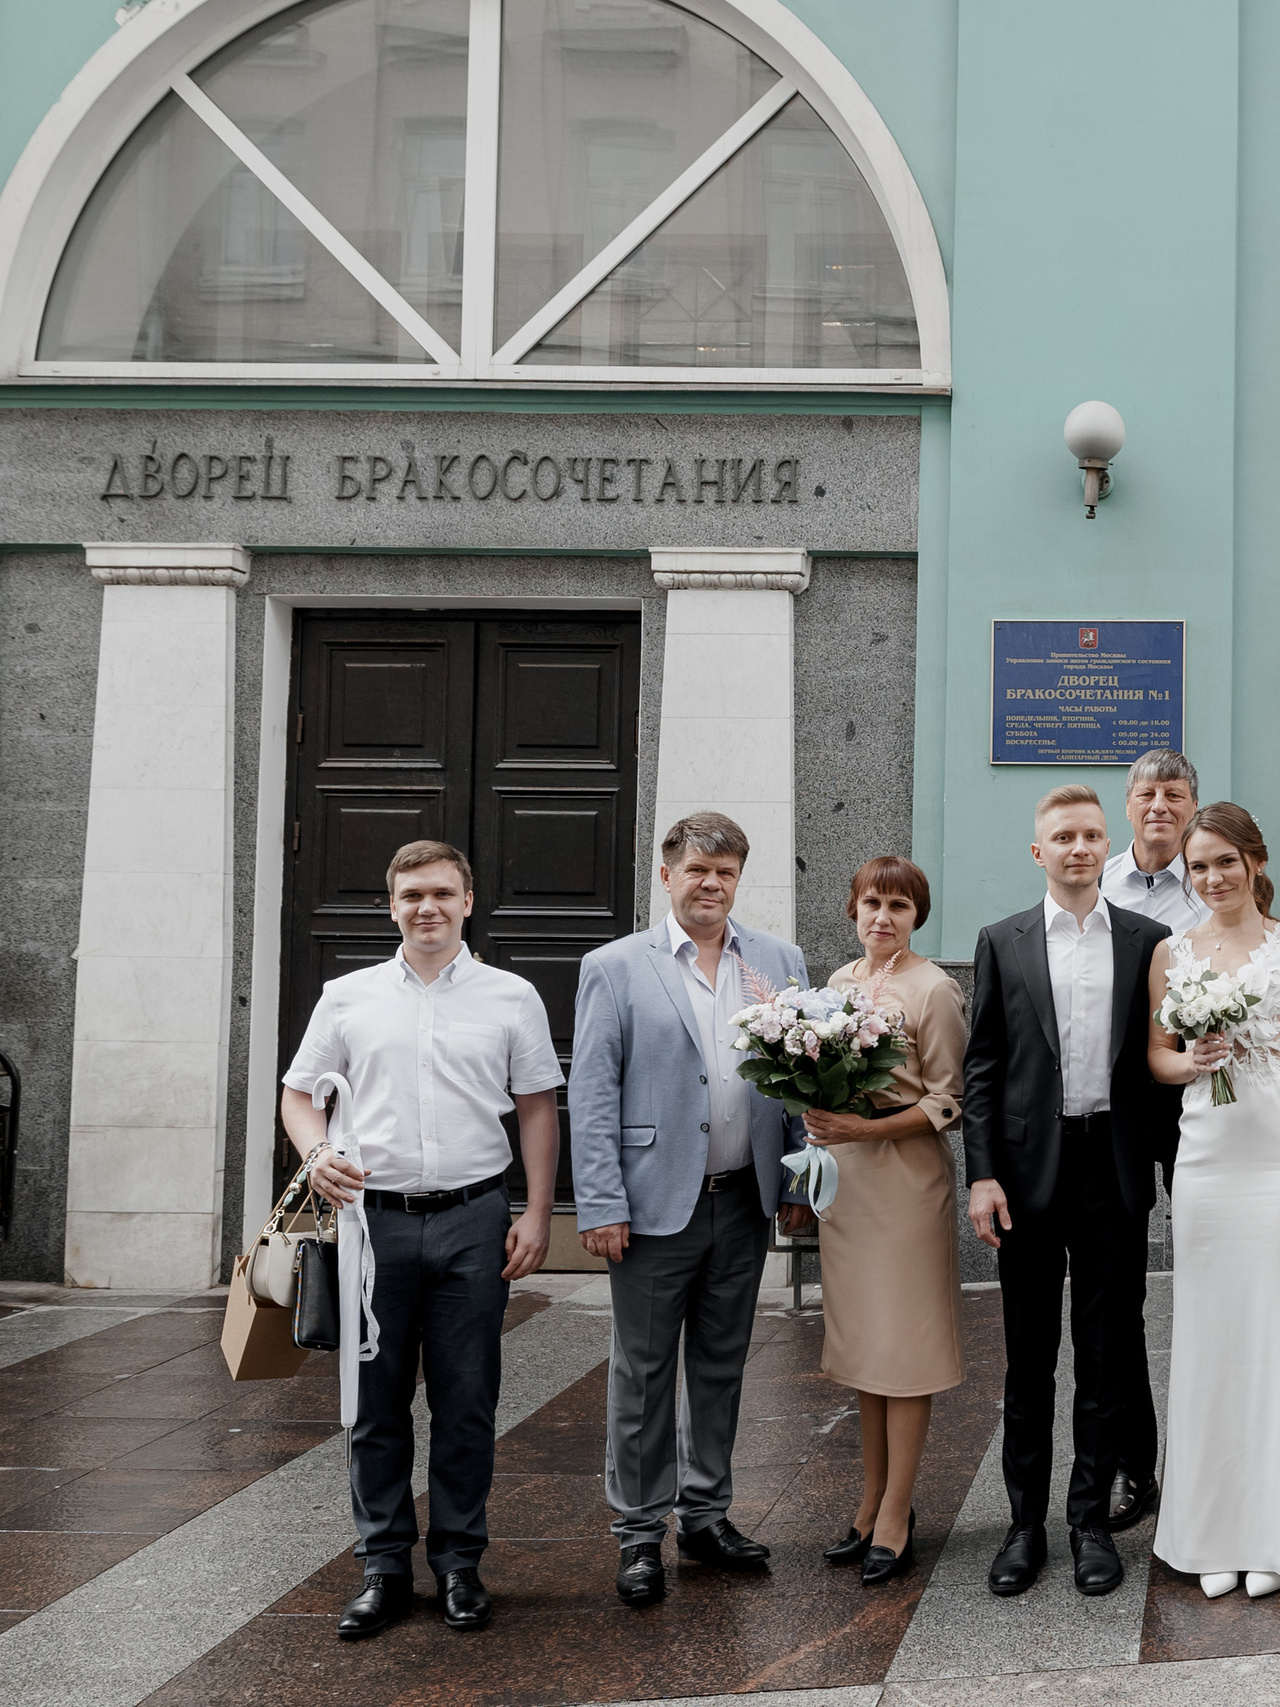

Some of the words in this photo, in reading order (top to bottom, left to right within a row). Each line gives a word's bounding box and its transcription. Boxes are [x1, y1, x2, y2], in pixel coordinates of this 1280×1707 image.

[101, 452, 292, 501] ДВОРЕЦ
[335, 452, 800, 504] БРАКОСОЧЕТАНИЯ
[1057, 675, 1119, 688] ДВОРЕЦ
[1006, 688, 1144, 700] БРАКОСОЧЕТАНИЯ
[1058, 705, 1083, 713] ЧАСЫ
[1150, 739, 1170, 747] 18.00
